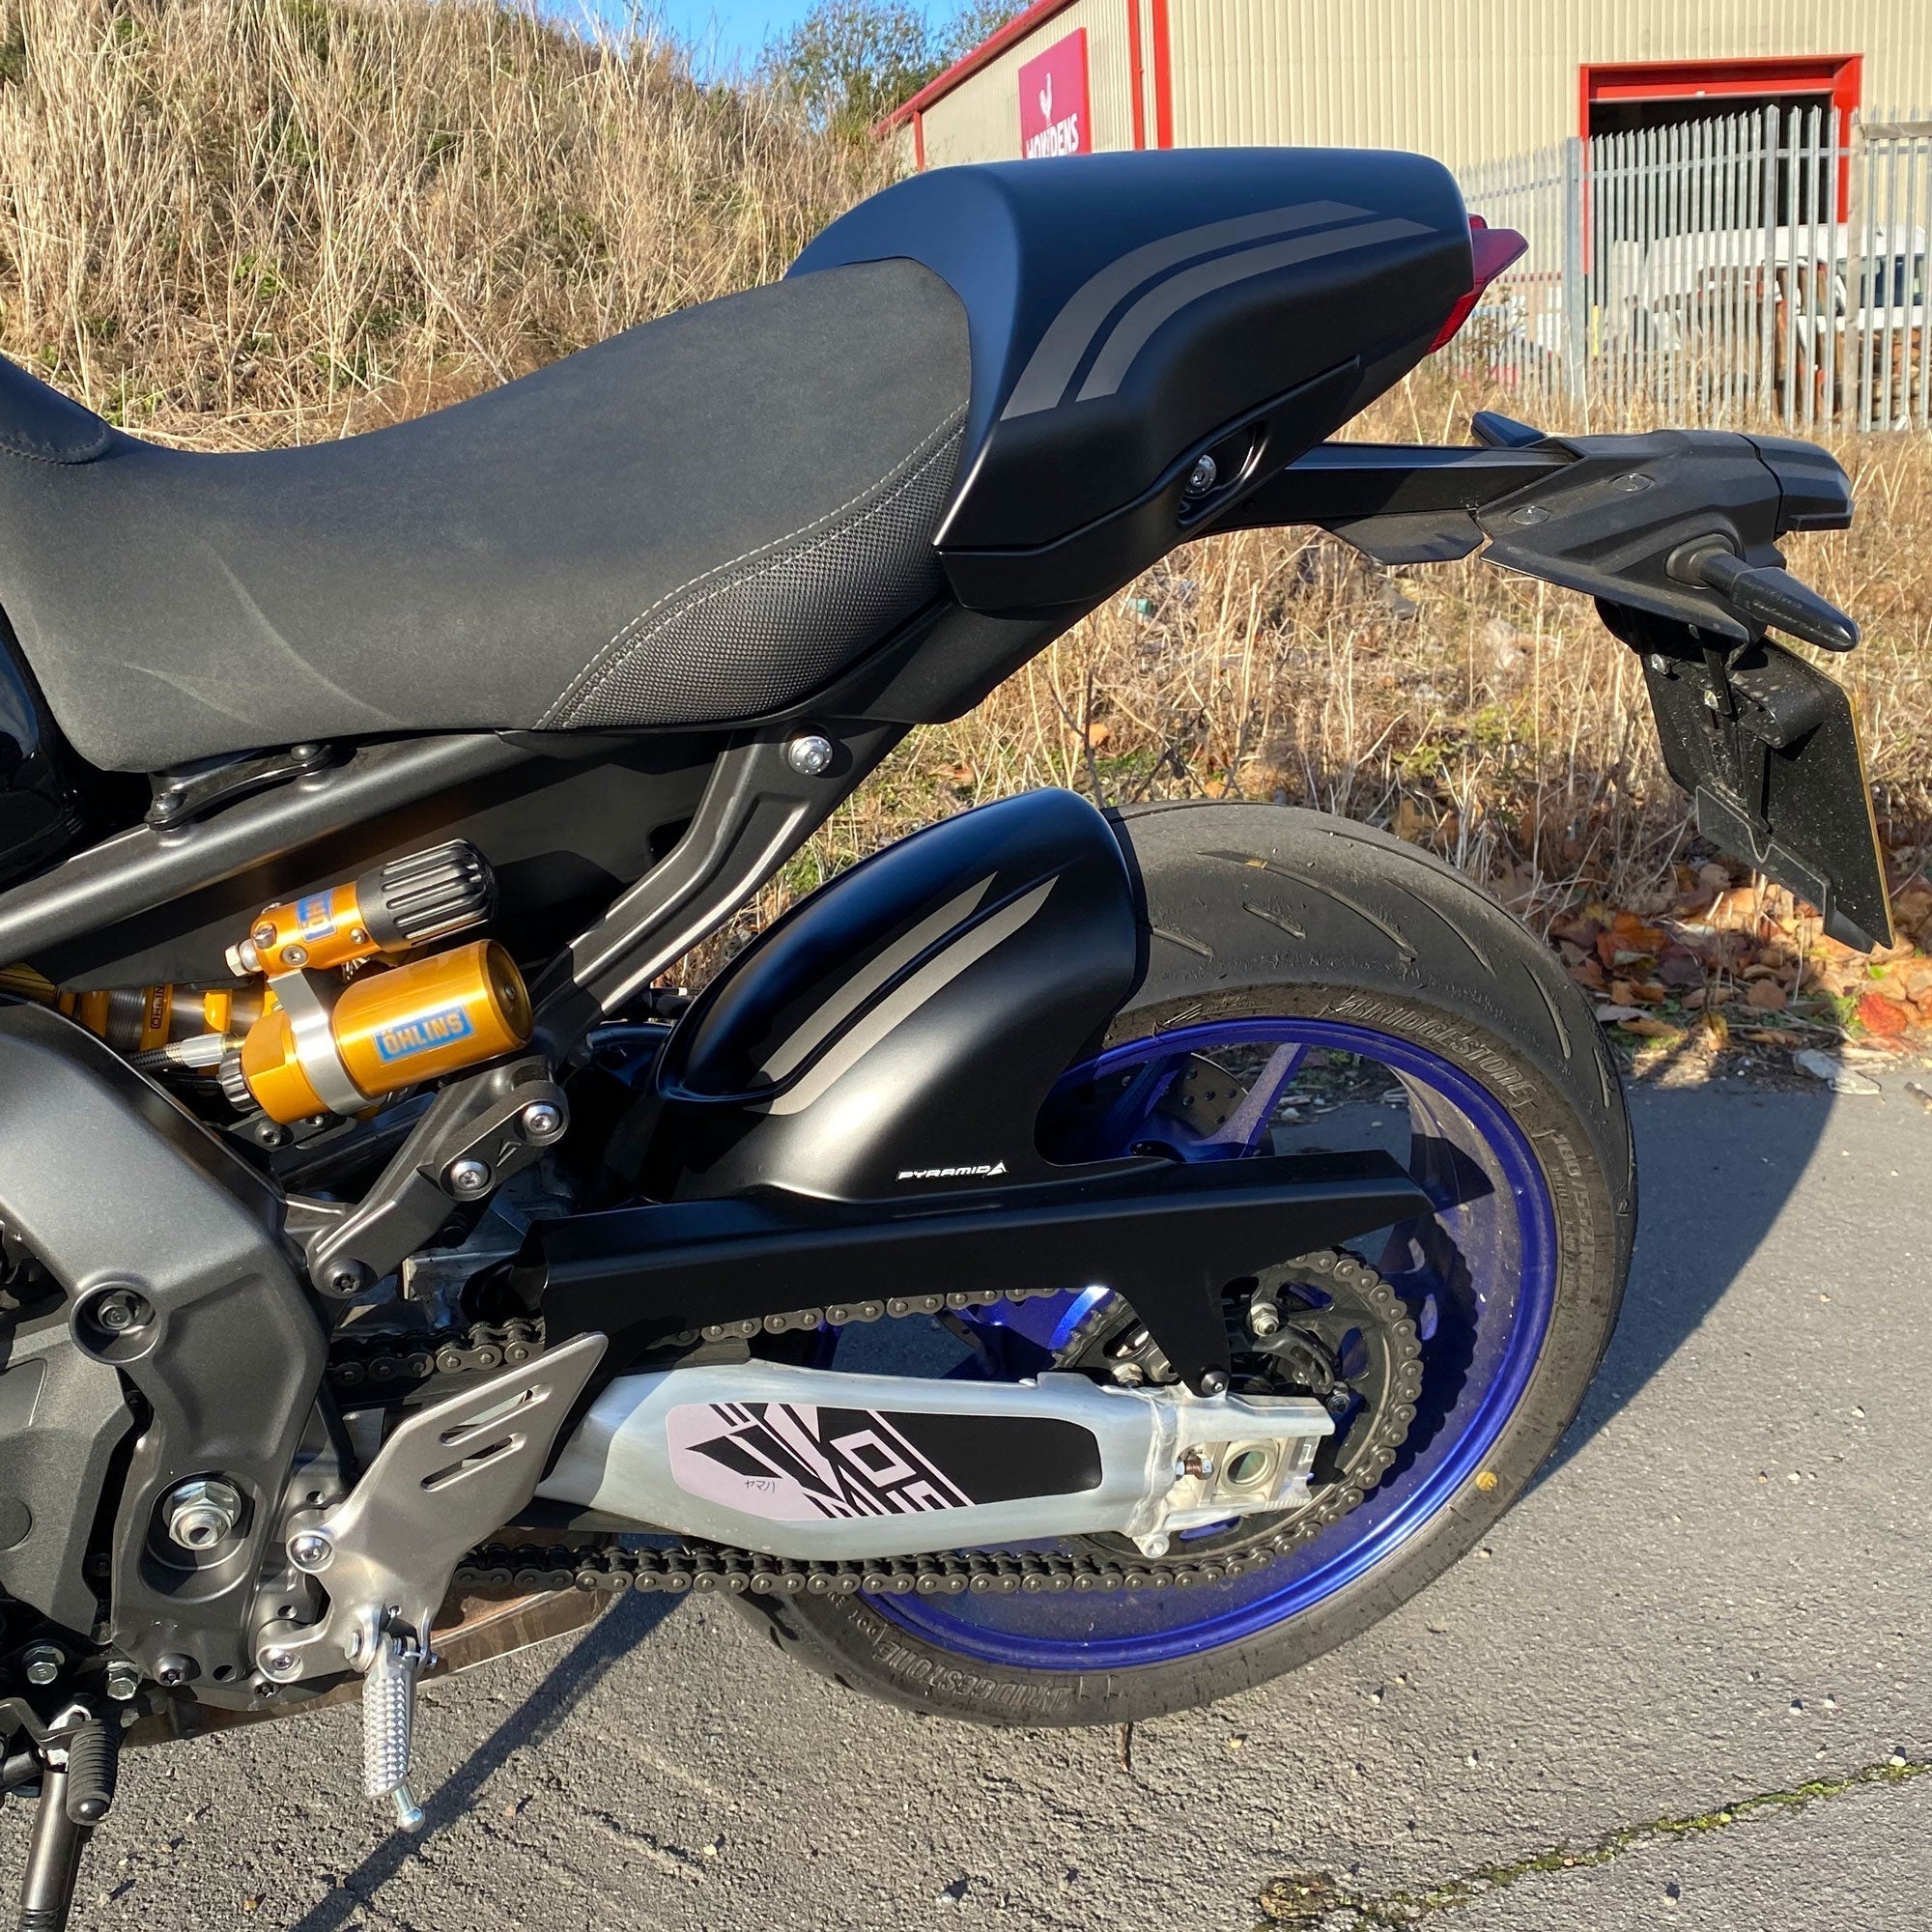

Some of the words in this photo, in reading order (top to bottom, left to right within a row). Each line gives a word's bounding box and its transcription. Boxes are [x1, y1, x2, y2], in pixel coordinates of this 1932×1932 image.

[1332, 994, 1538, 1097] BRIDGESTONE
[897, 1165, 991, 1179] PYRAMID
[872, 1640, 1073, 1713] BRIDGESTONE
